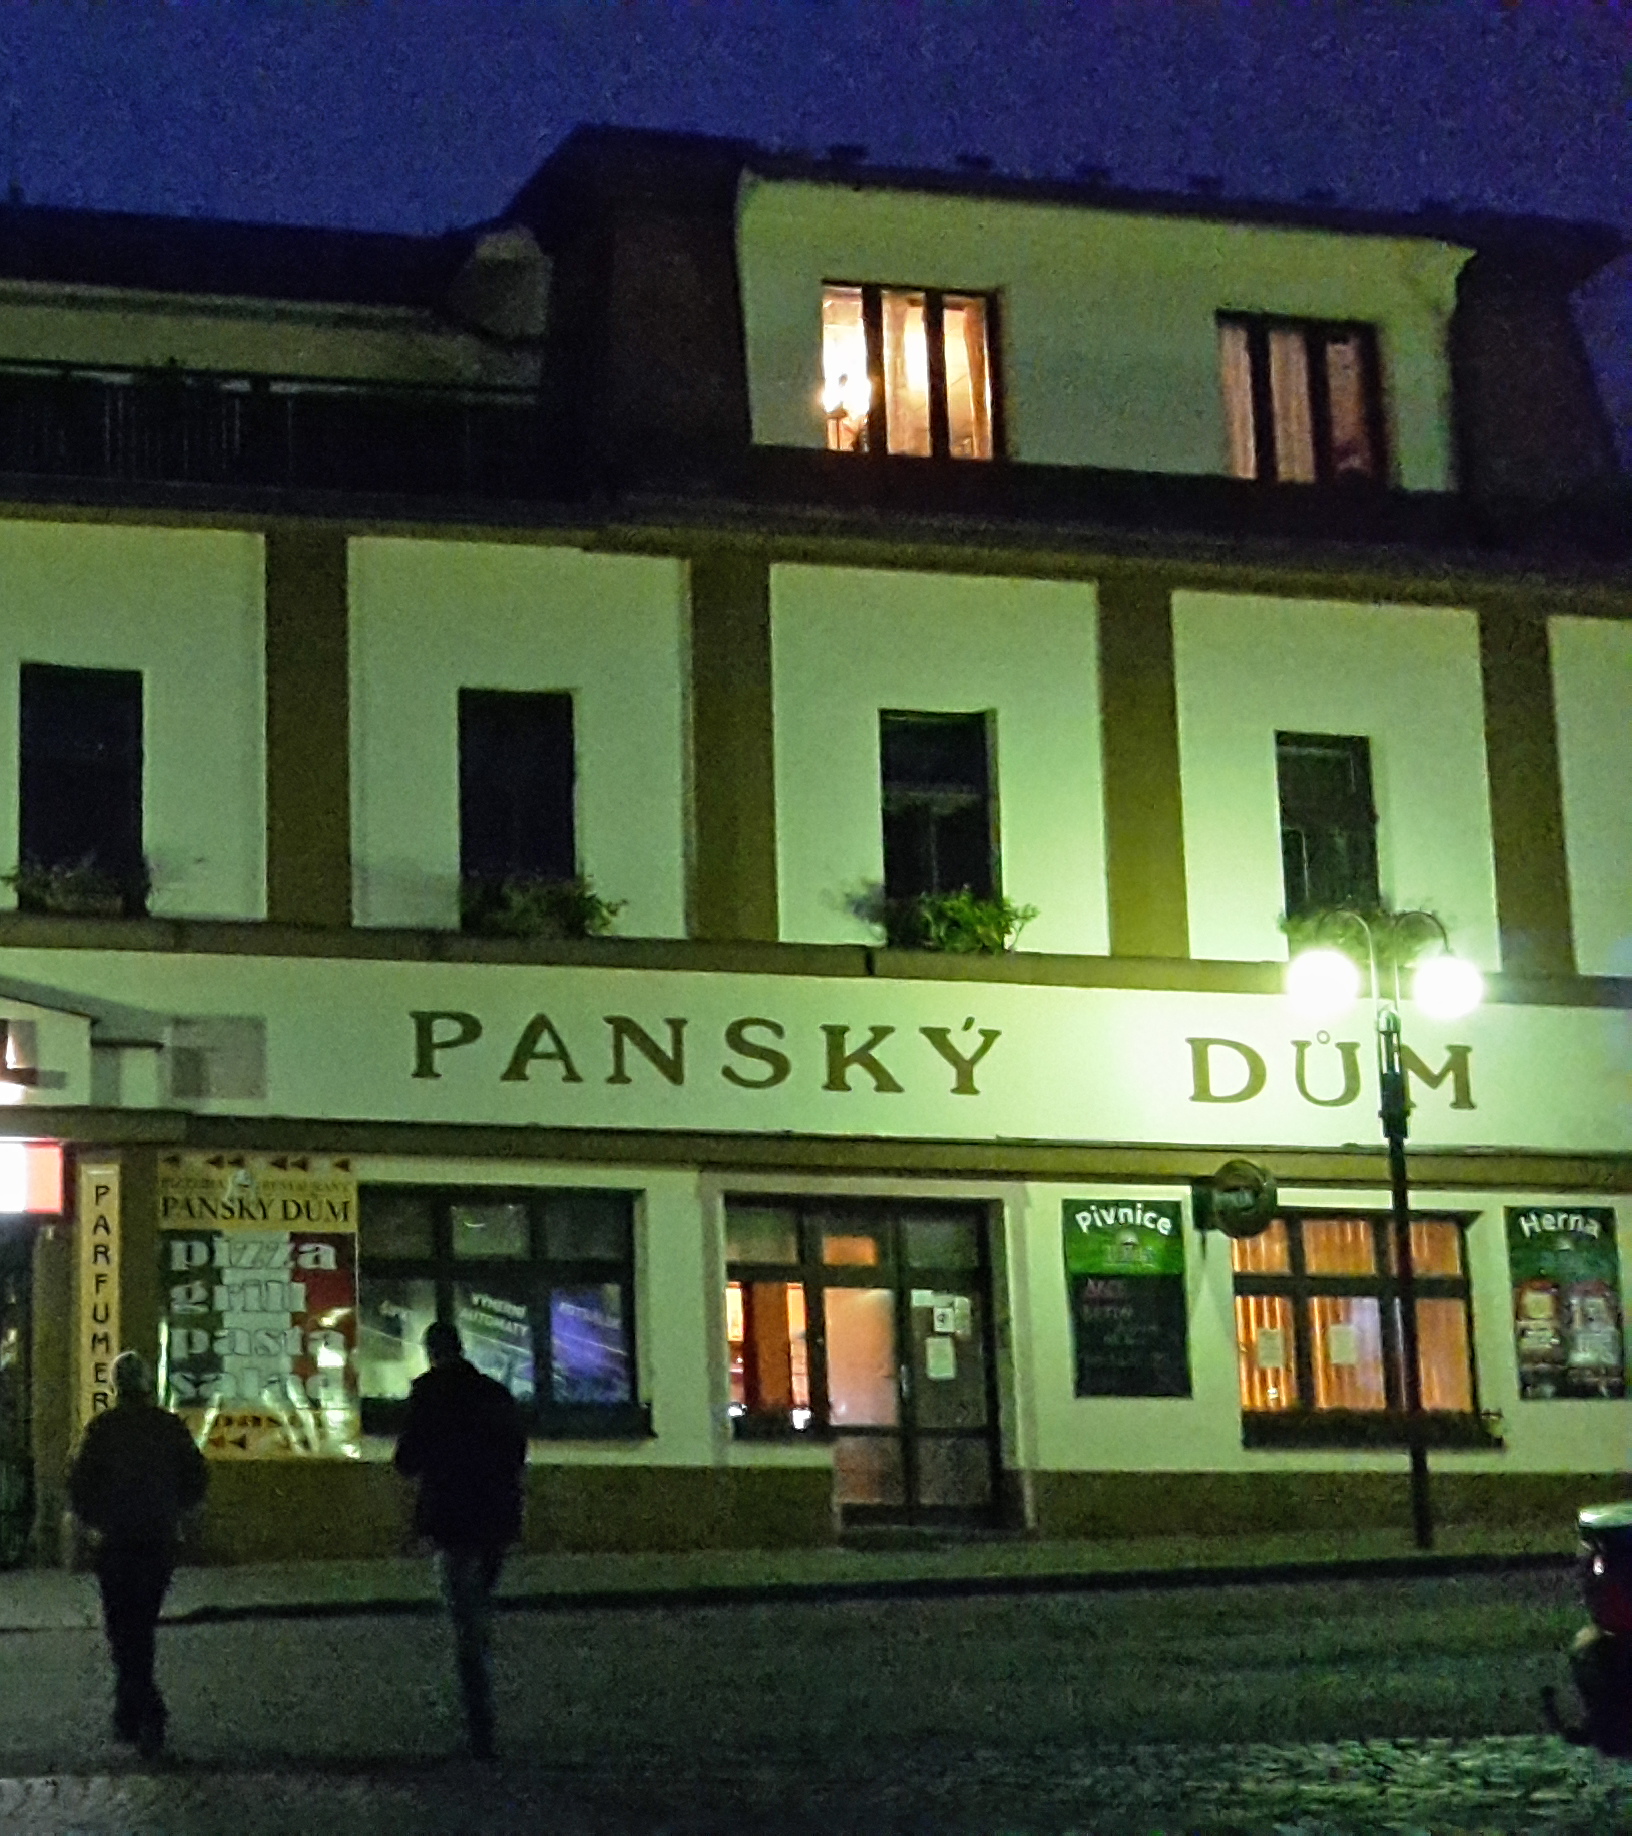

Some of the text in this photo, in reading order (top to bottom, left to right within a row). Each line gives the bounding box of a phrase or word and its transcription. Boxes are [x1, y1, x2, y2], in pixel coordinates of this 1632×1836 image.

[409, 1009, 1478, 1110] PANSKÝ DŮM
[1074, 1202, 1173, 1236] Pivnice
[1519, 1211, 1601, 1239] Herna
[170, 1238, 337, 1271] pizza
[170, 1280, 306, 1315] grill
[170, 1325, 346, 1359] pasta
